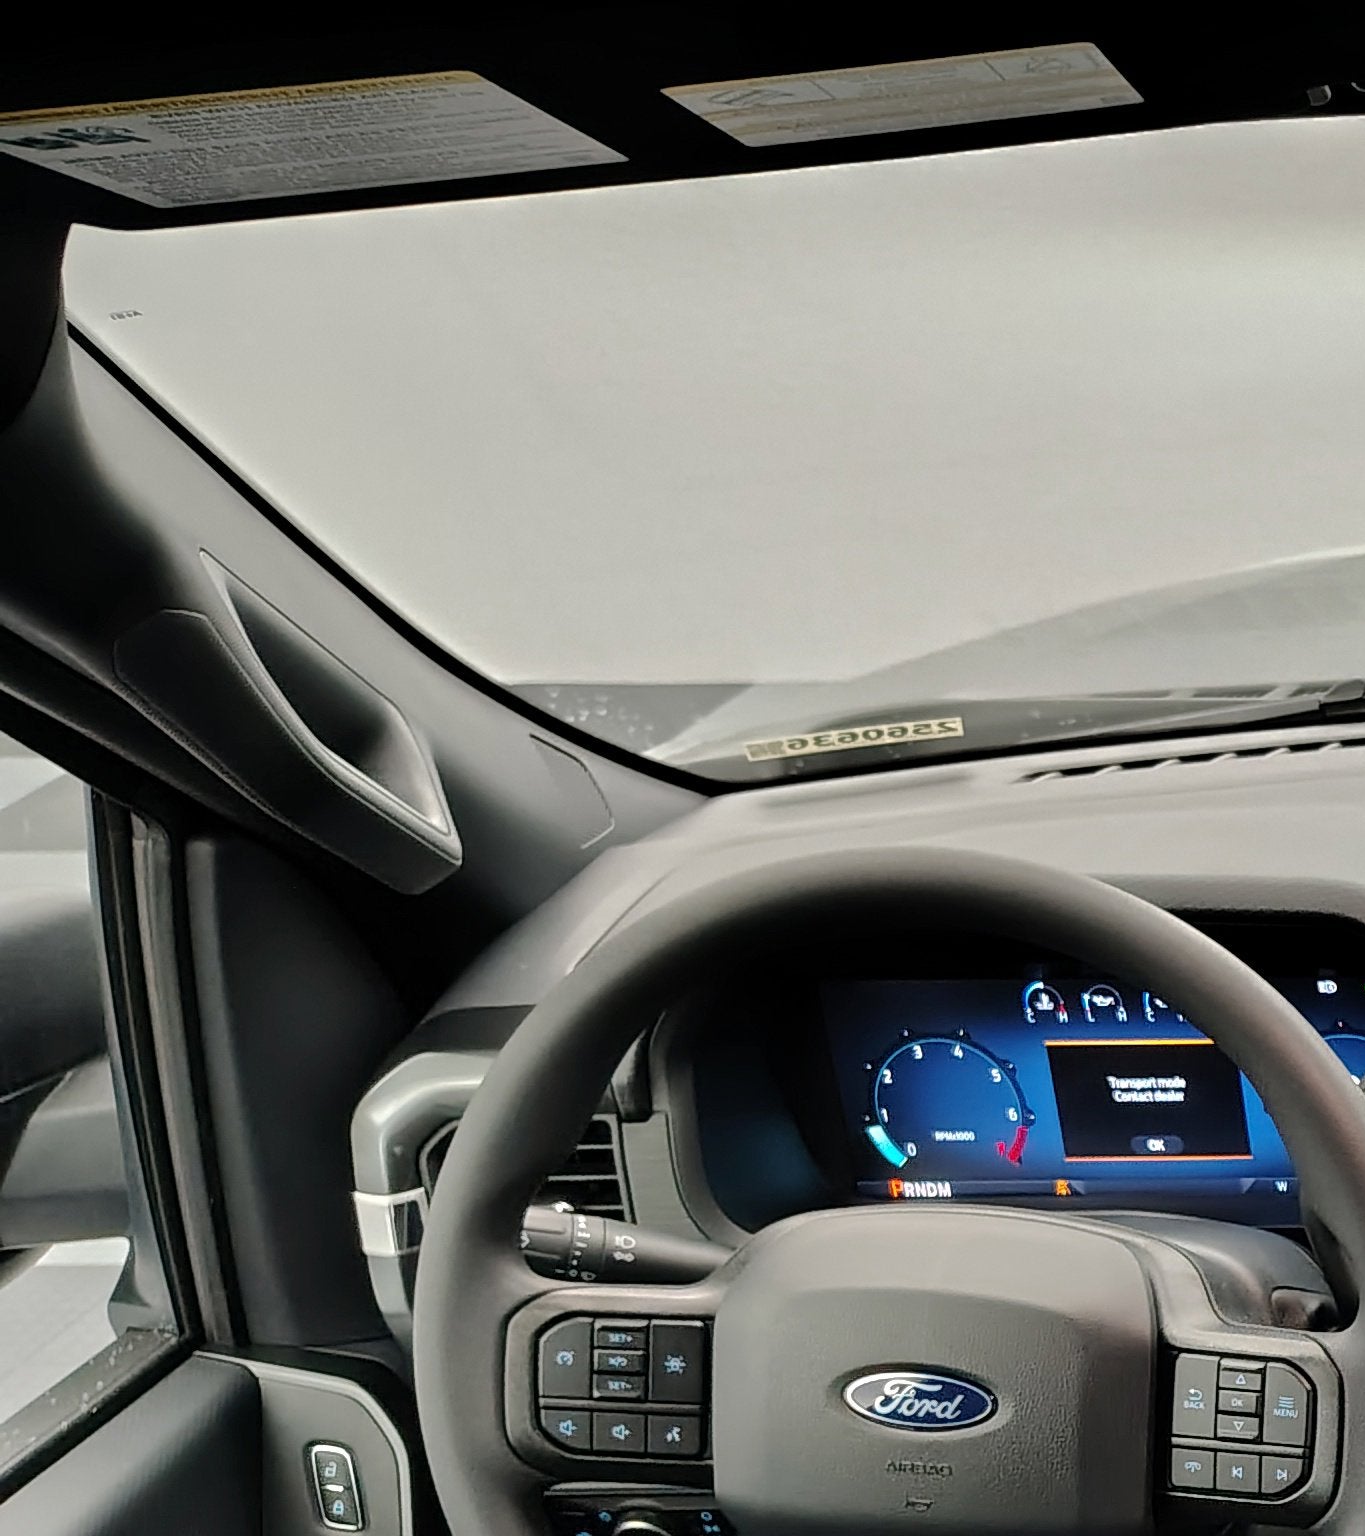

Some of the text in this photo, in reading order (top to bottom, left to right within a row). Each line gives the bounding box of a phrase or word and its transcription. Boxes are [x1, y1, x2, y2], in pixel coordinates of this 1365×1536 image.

[912, 1044, 923, 1060] 3
[953, 1044, 964, 1059] 4
[882, 1069, 893, 1084] 2
[990, 1068, 1002, 1083] 5
[1106, 1076, 1187, 1090] Transport mode
[1112, 1090, 1154, 1102] Contact
[881, 1108, 889, 1124] 1
[1007, 1108, 1018, 1122] 6
[907, 1142, 917, 1157] 0
[1146, 1138, 1166, 1152] OK
[874, 1379, 965, 1420] Ford
[1183, 1401, 1205, 1410] BACK
[1231, 1398, 1244, 1407] OK
[1273, 1408, 1299, 1419] MENU
